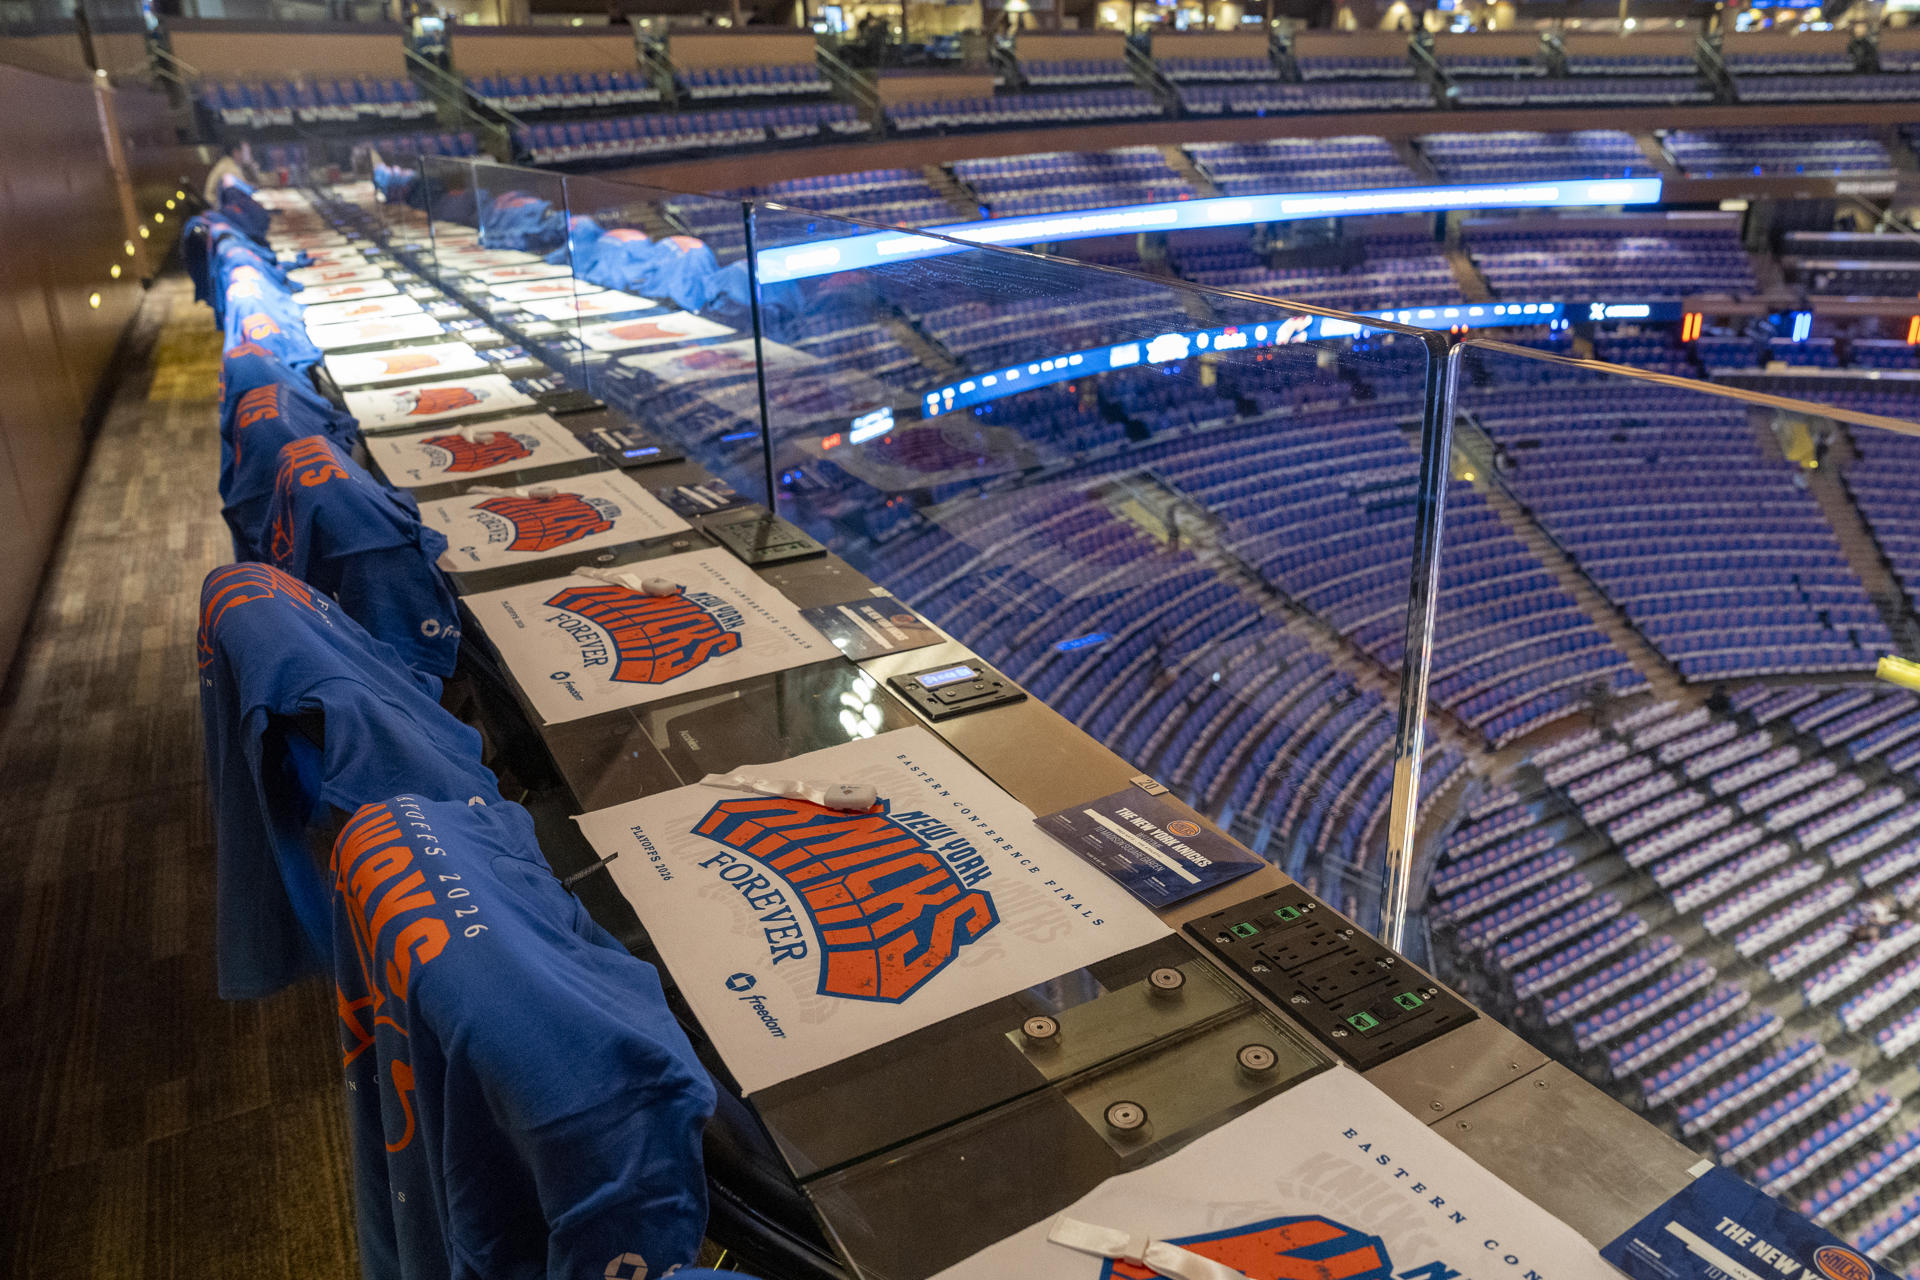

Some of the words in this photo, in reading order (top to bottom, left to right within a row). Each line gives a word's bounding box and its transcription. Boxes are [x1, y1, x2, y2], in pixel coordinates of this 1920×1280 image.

[545, 613, 608, 668] FOREVER
[1138, 779, 1160, 790] 20
[630, 825, 661, 862] PLAYOFFS
[890, 811, 958, 841] NEW
[937, 837, 992, 888] YORK
[896, 754, 950, 797] EASTERN
[953, 801, 1040, 874] CONFERENCE
[1044, 879, 1104, 926] FINALS
[1115, 807, 1138, 820] THE
[1130, 817, 1157, 831] NEW
[1150, 828, 1180, 847] YORK
[1171, 843, 1213, 868] KNICKS
[439, 873, 489, 938] 2026
[689, 797, 1000, 1004] KNICKS
[698, 851, 808, 966] FOREVER
[738, 995, 786, 1039] freedom
[1342, 1127, 1467, 1225] EASTERN
[1715, 1216, 1756, 1248] THE
[1749, 1240, 1802, 1276] NEW
